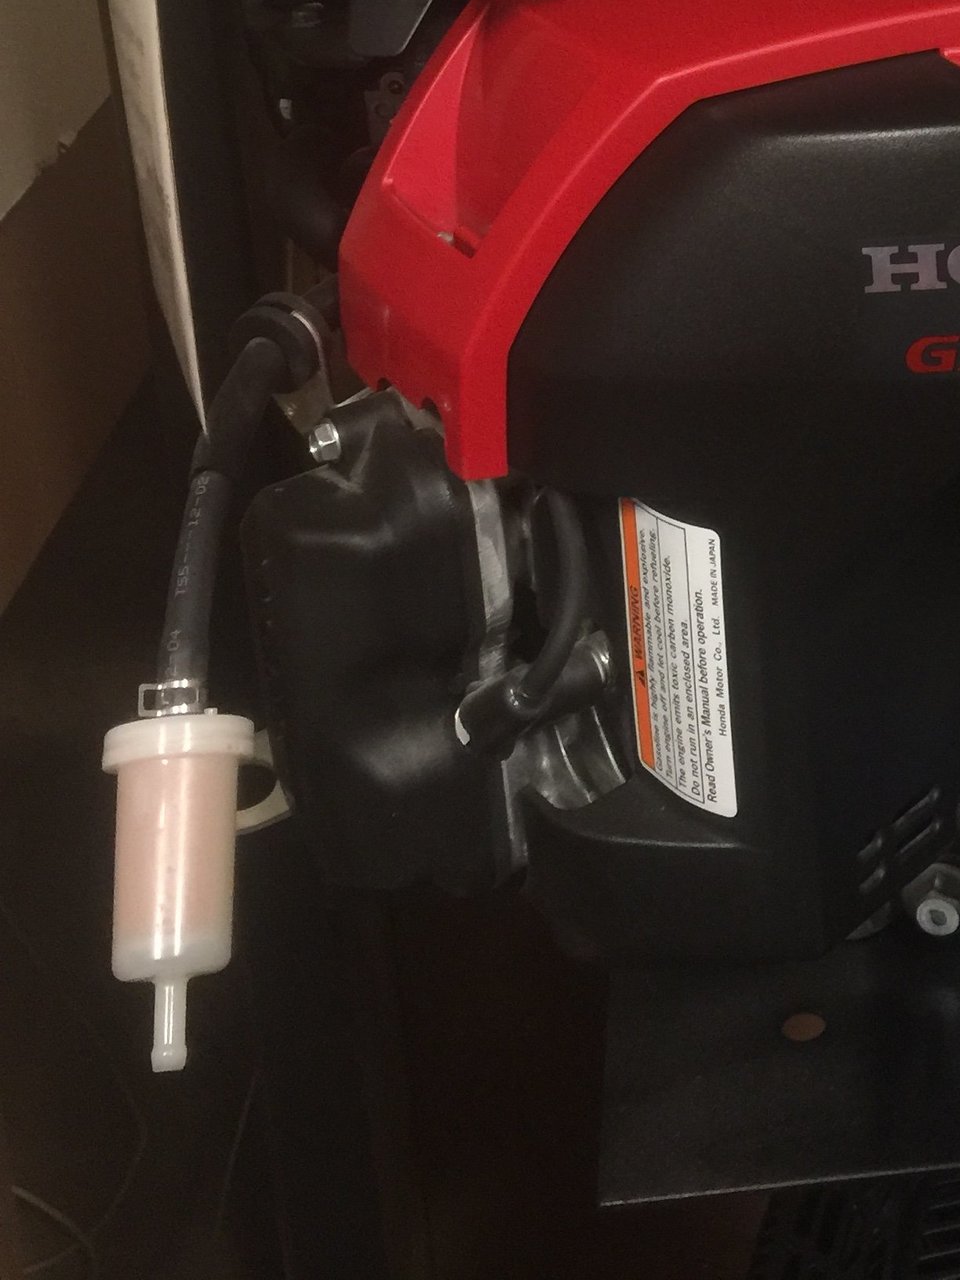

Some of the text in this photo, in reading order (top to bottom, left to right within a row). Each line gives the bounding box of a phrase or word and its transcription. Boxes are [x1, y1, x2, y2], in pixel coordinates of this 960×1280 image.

[639, 529, 648, 584] explosive.
[649, 529, 657, 582] refueling.
[710, 569, 716, 578] IN
[630, 585, 642, 659] WARNING
[652, 586, 660, 623] before
[645, 613, 654, 672] flammable
[712, 617, 720, 635] Ltd.
[714, 642, 722, 661] Co.,
[663, 556, 687, 787] The engine emits toxic carbon monoxide.
[715, 667, 724, 698] Motor
[649, 676, 657, 710] highly
[681, 620, 700, 796] Do not run in an enclosed area.
[693, 589, 717, 803] Read Owner's Manual before operation.
[652, 713, 658, 721] is
[663, 715, 671, 752] engine
[718, 704, 726, 736] Honda
[654, 725, 662, 771] Gasoline
